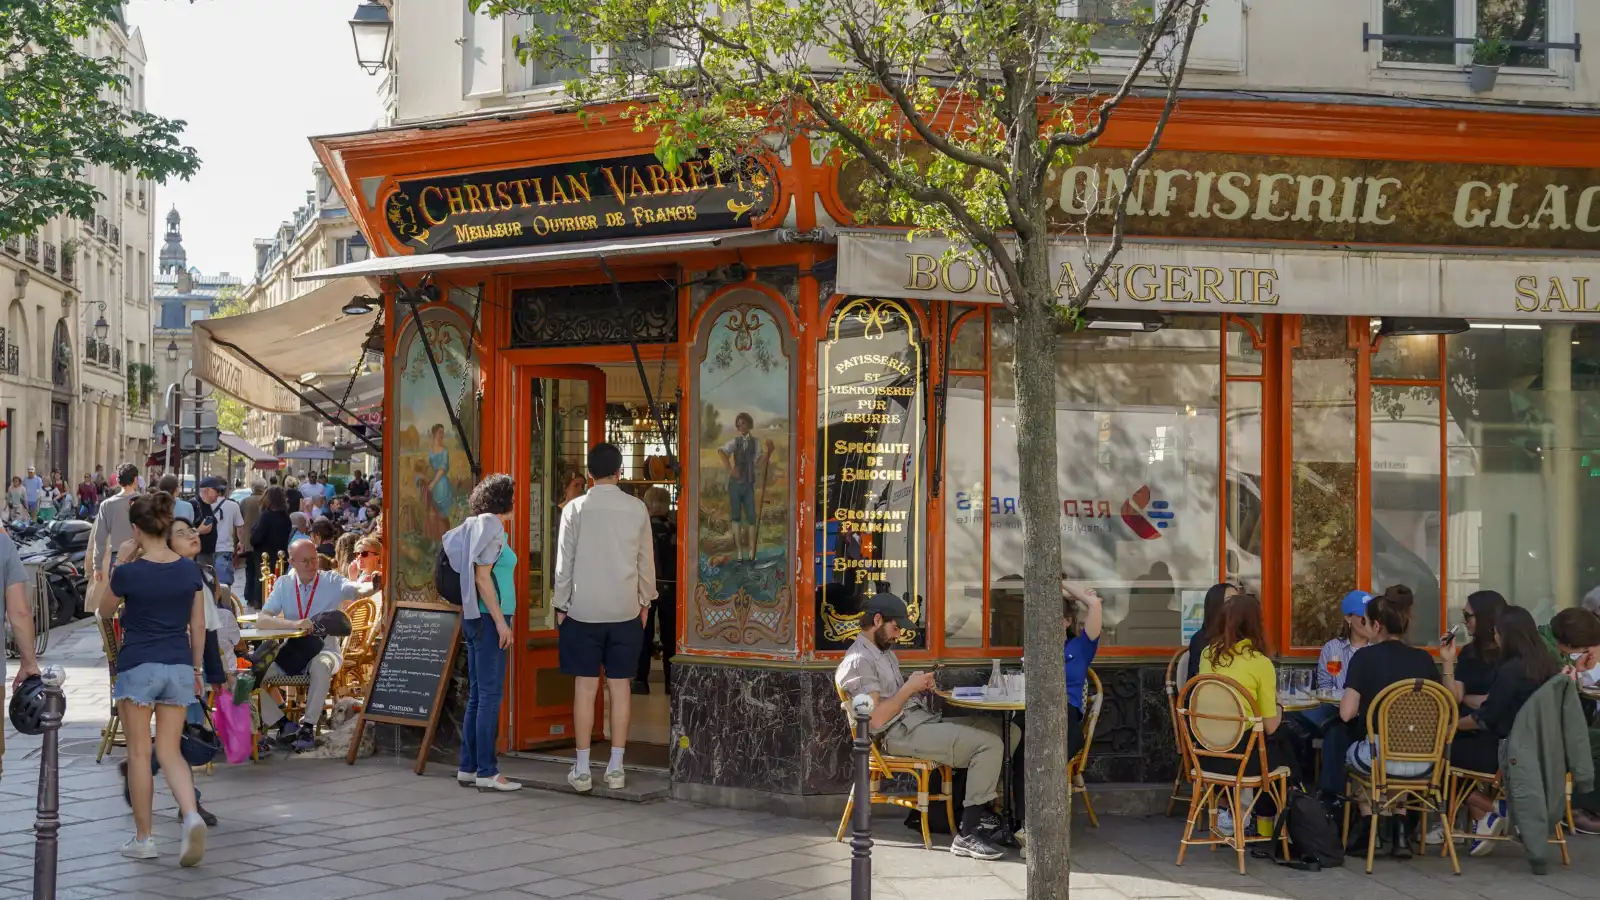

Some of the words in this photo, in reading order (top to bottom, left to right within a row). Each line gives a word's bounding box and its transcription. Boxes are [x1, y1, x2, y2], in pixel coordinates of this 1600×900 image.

[419, 172, 592, 227] CHRISTIAN
[454, 222, 524, 244] MEILLEUR
[533, 214, 599, 236] OUVRIER
[606, 212, 626, 227] DE
[633, 204, 697, 226] FRANCE
[904, 252, 1280, 306] BOUANGERIE
[1514, 275, 1600, 312] SAL
[835, 354, 910, 376] PATISSERIE
[864, 373, 881, 382] ET
[830, 386, 914, 396] VIENNOISERIE
[857, 400, 886, 410] PUR
[843, 413, 901, 424] BEURRE
[834, 440, 910, 455] SPECIALITE
[866, 457, 883, 467] DE
[841, 467, 903, 482] BRIOCHE
[834, 508, 907, 521] CROISSANT
[833, 557, 908, 571] BISCUITERIE
[855, 569, 887, 584] FINE
